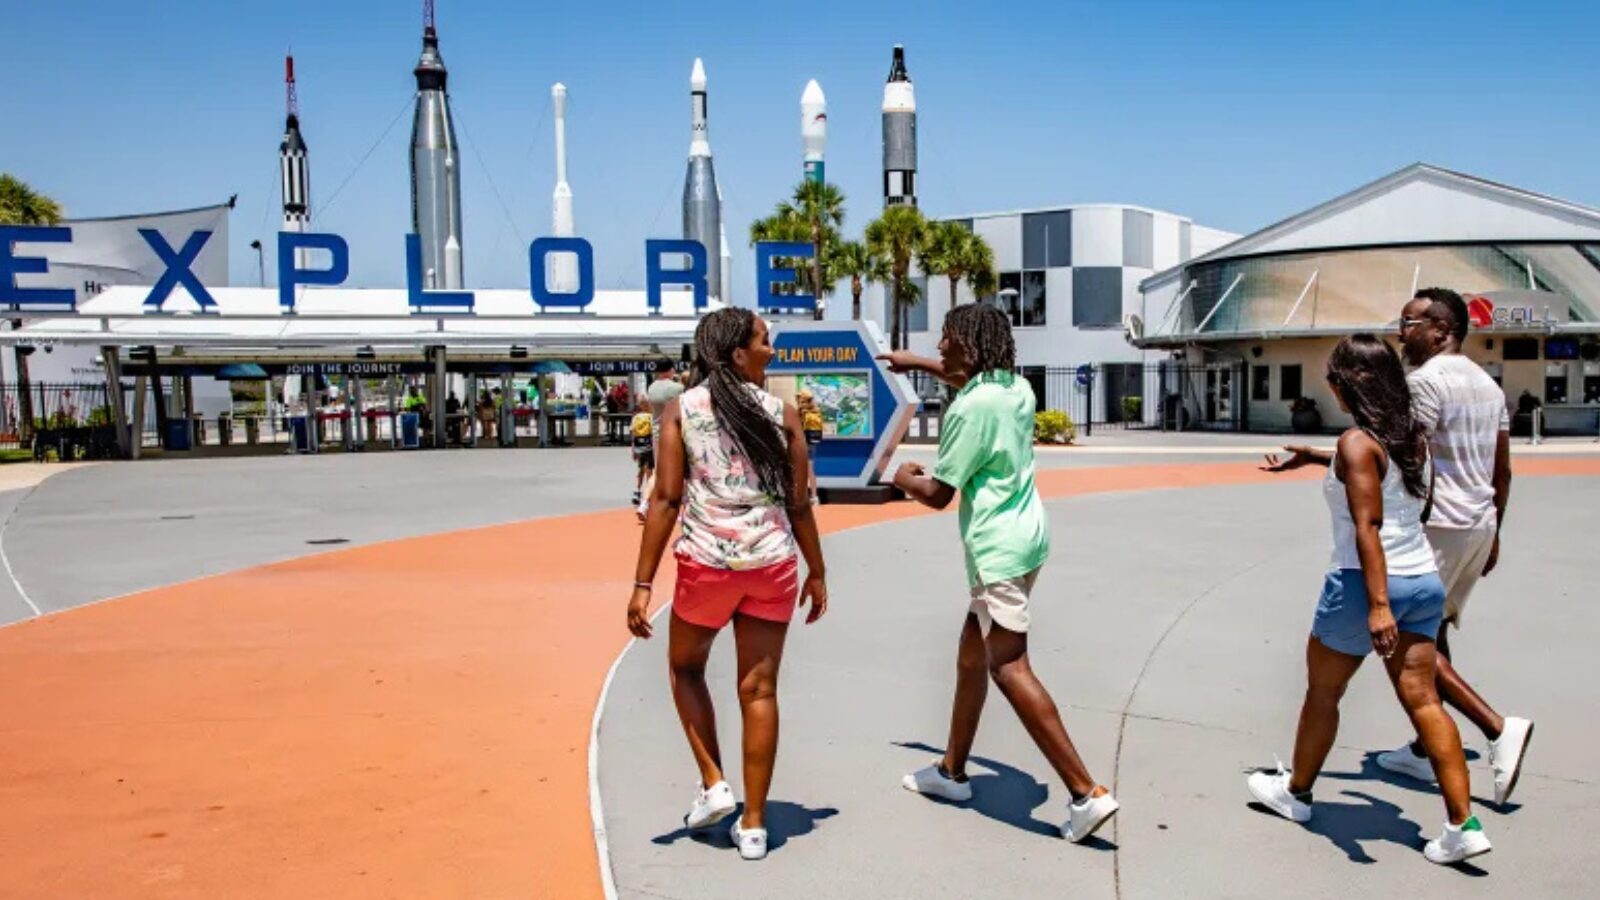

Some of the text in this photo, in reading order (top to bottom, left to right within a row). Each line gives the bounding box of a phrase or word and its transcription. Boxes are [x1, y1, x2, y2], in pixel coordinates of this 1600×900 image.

[0, 225, 815, 312] EXPLORE
[1493, 306, 1557, 325] CALL
[778, 347, 858, 363] PLAN YOUR DAY
[287, 363, 401, 374] JOIN THE JOURNEY
[589, 361, 615, 371] JOIN
[620, 361, 639, 371] THE
